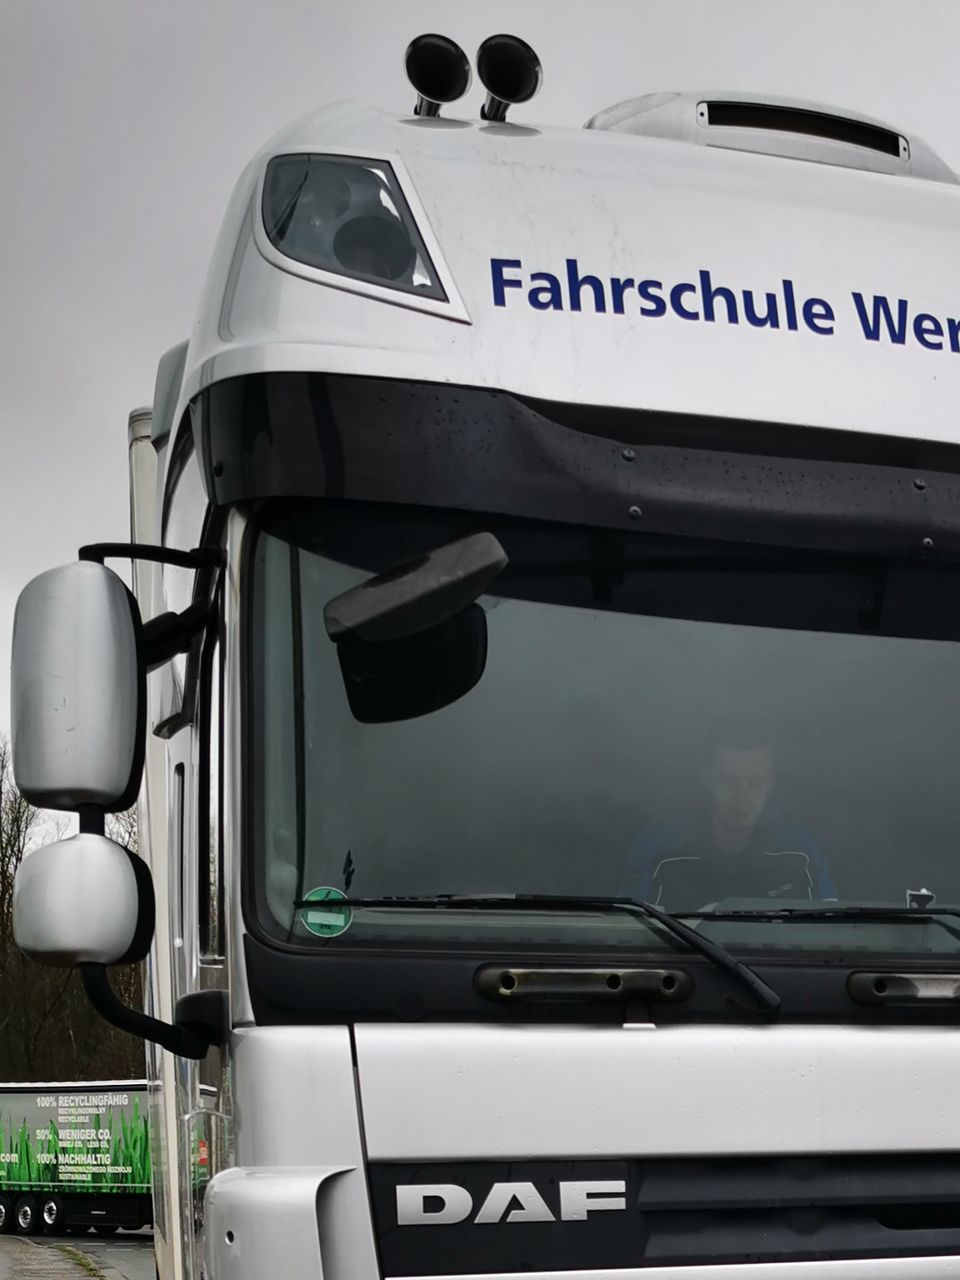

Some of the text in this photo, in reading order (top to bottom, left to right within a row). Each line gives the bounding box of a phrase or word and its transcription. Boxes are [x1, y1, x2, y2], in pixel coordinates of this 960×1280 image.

[490, 258, 835, 335] Fahrschule
[36, 1093, 128, 1107] 100% RECYCLINGFÄHIG
[58, 1129, 97, 1140] WENIGER
[36, 1154, 111, 1164] 100% NACHHALTIG
[395, 1180, 626, 1225] DAF
